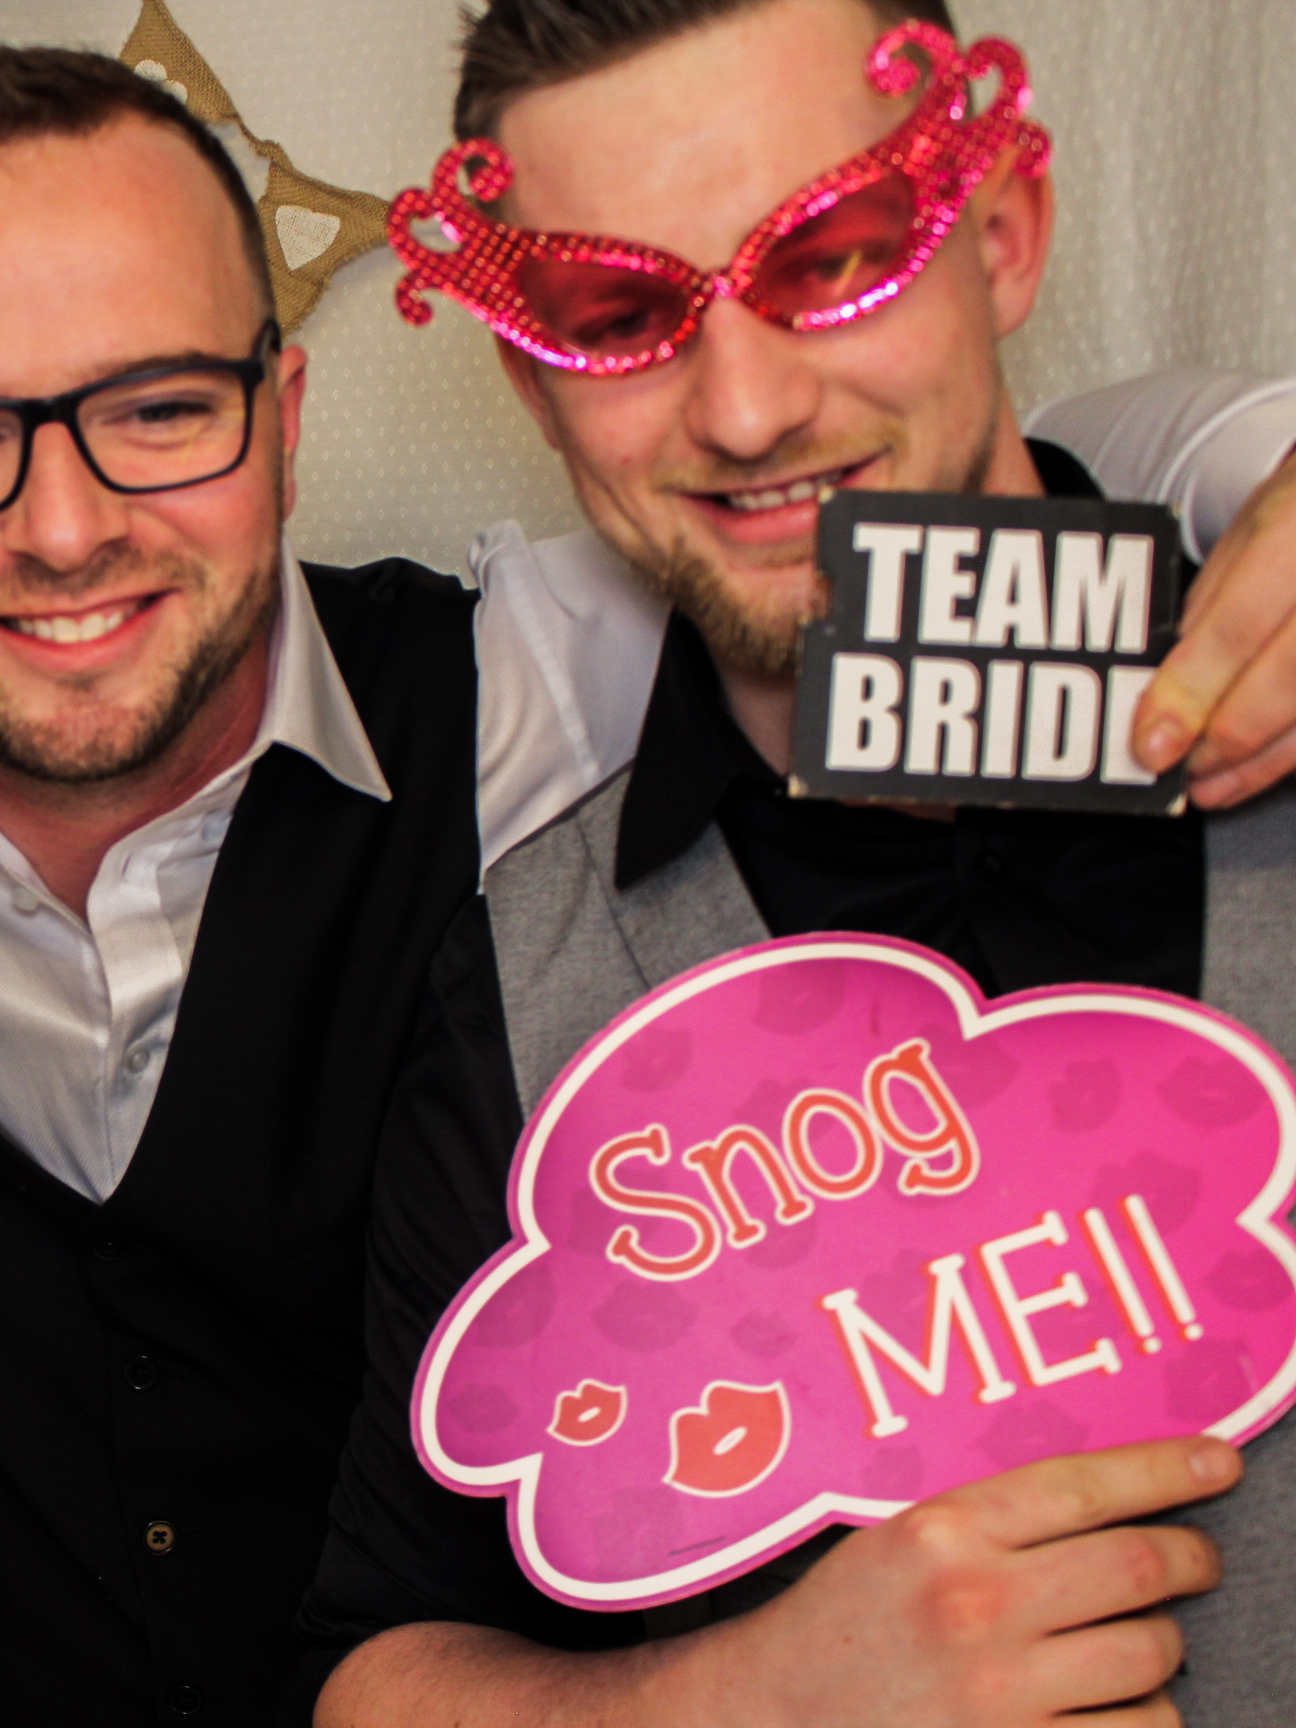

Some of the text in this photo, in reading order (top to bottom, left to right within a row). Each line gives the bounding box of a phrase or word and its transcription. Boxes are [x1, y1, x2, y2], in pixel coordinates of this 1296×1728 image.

[852, 522, 1155, 654] TEAM
[588, 1038, 980, 1282] Snog
[816, 1195, 1204, 1438] ME!!
